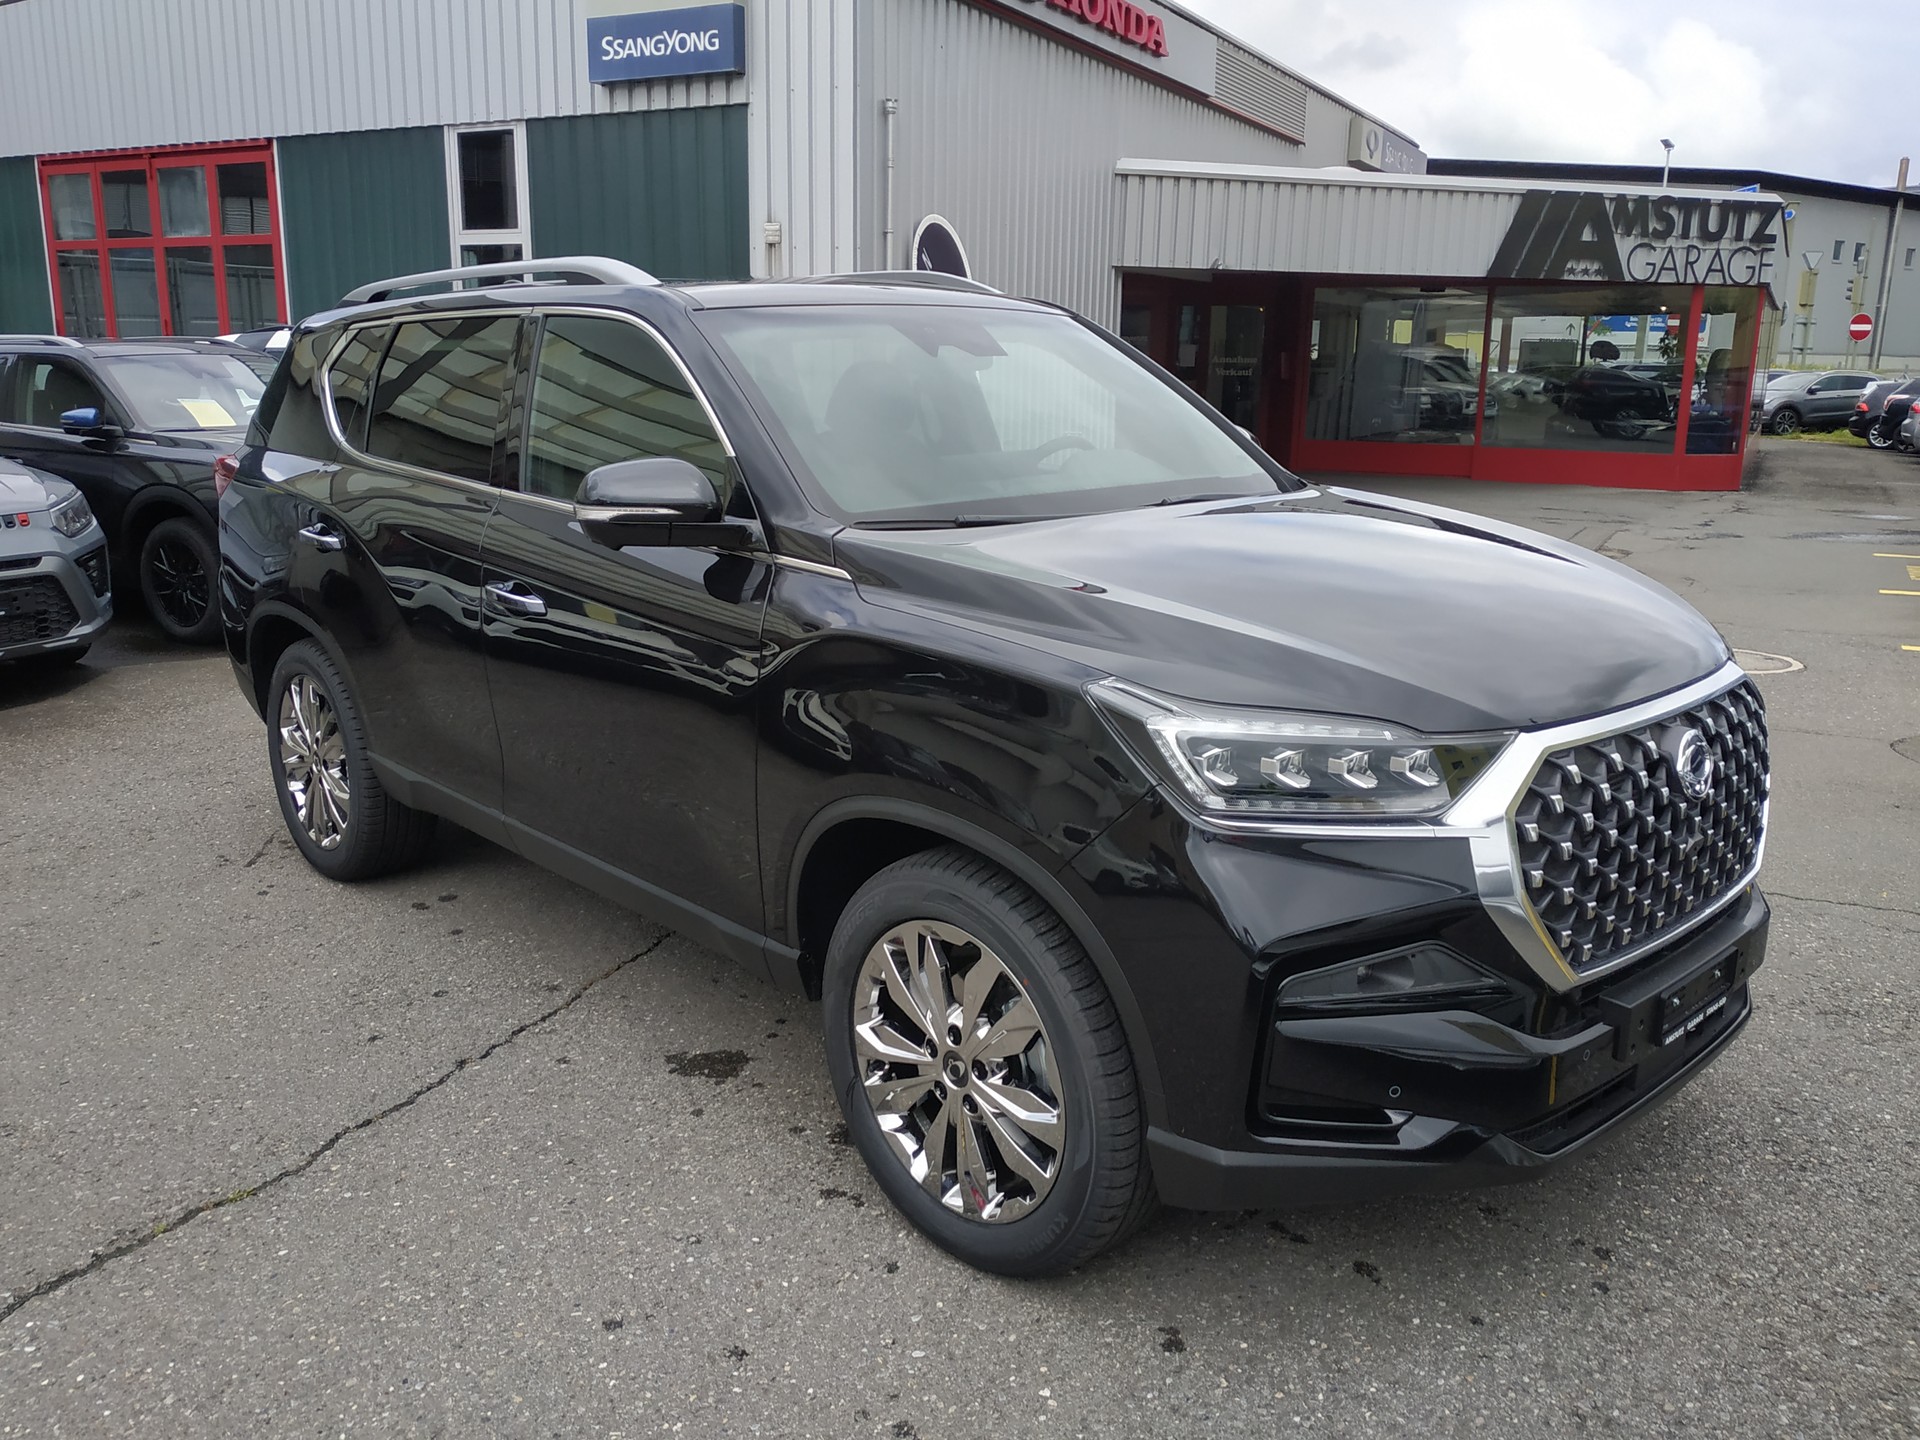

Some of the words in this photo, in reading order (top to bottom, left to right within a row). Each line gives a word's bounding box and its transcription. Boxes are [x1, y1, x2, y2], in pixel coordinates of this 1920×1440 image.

[1626, 242, 1776, 285] GARAGE
[1212, 355, 1258, 364] Annahme
[1215, 367, 1253, 376] Verkauf
